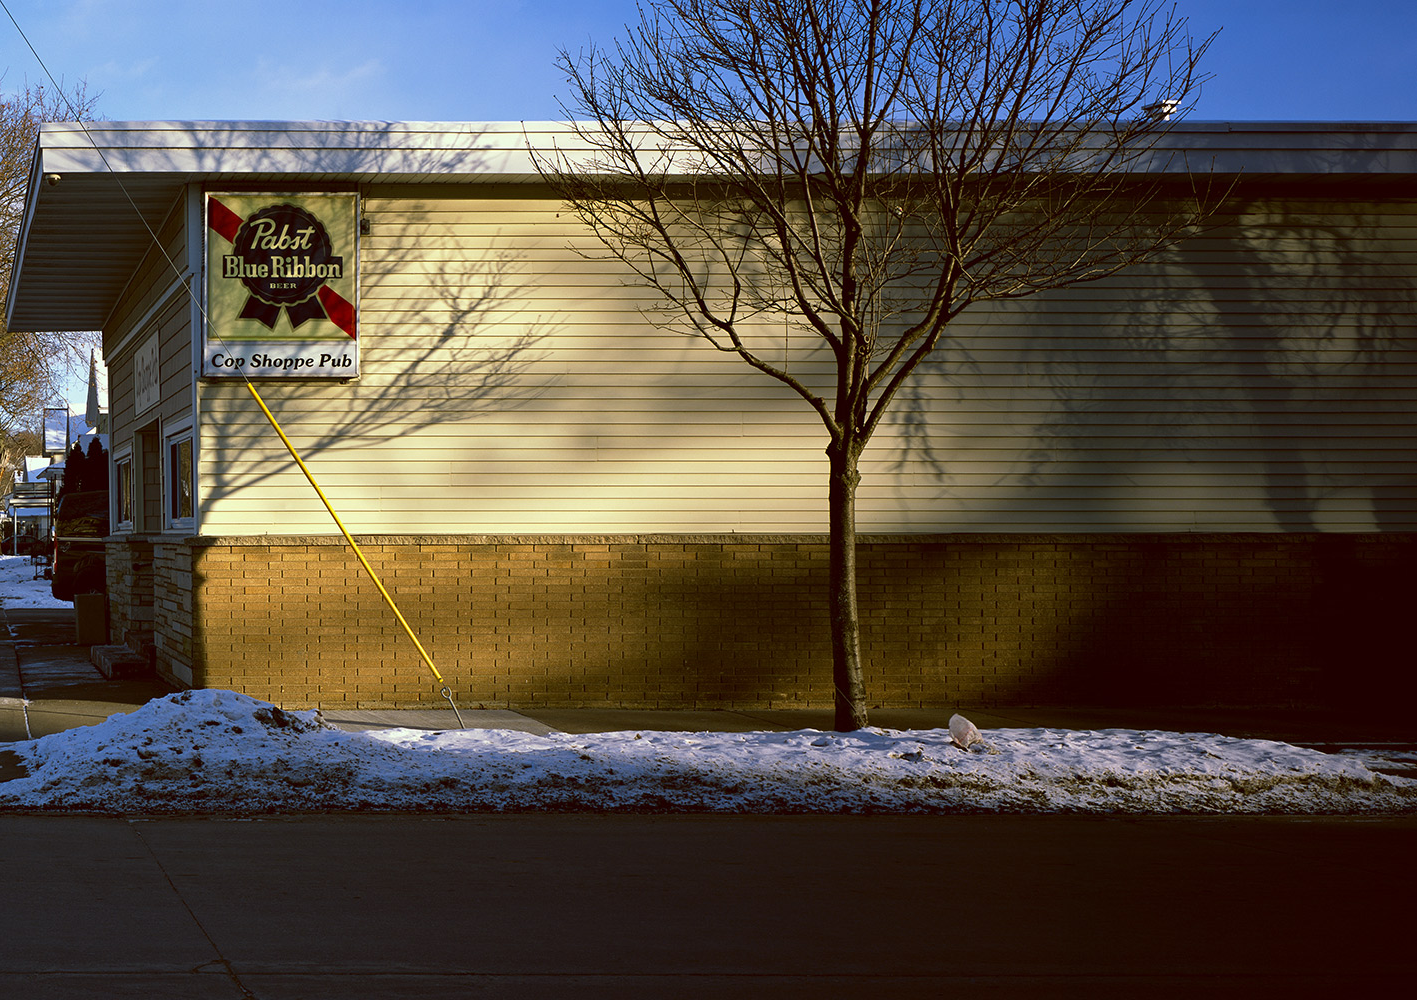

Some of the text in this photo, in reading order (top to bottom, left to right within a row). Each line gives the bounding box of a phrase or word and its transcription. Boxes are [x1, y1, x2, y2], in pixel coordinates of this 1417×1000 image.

[250, 218, 315, 250] Pabst
[224, 255, 342, 278] Blue Ribbon
[211, 353, 352, 370] Cop Shoppe Pub
